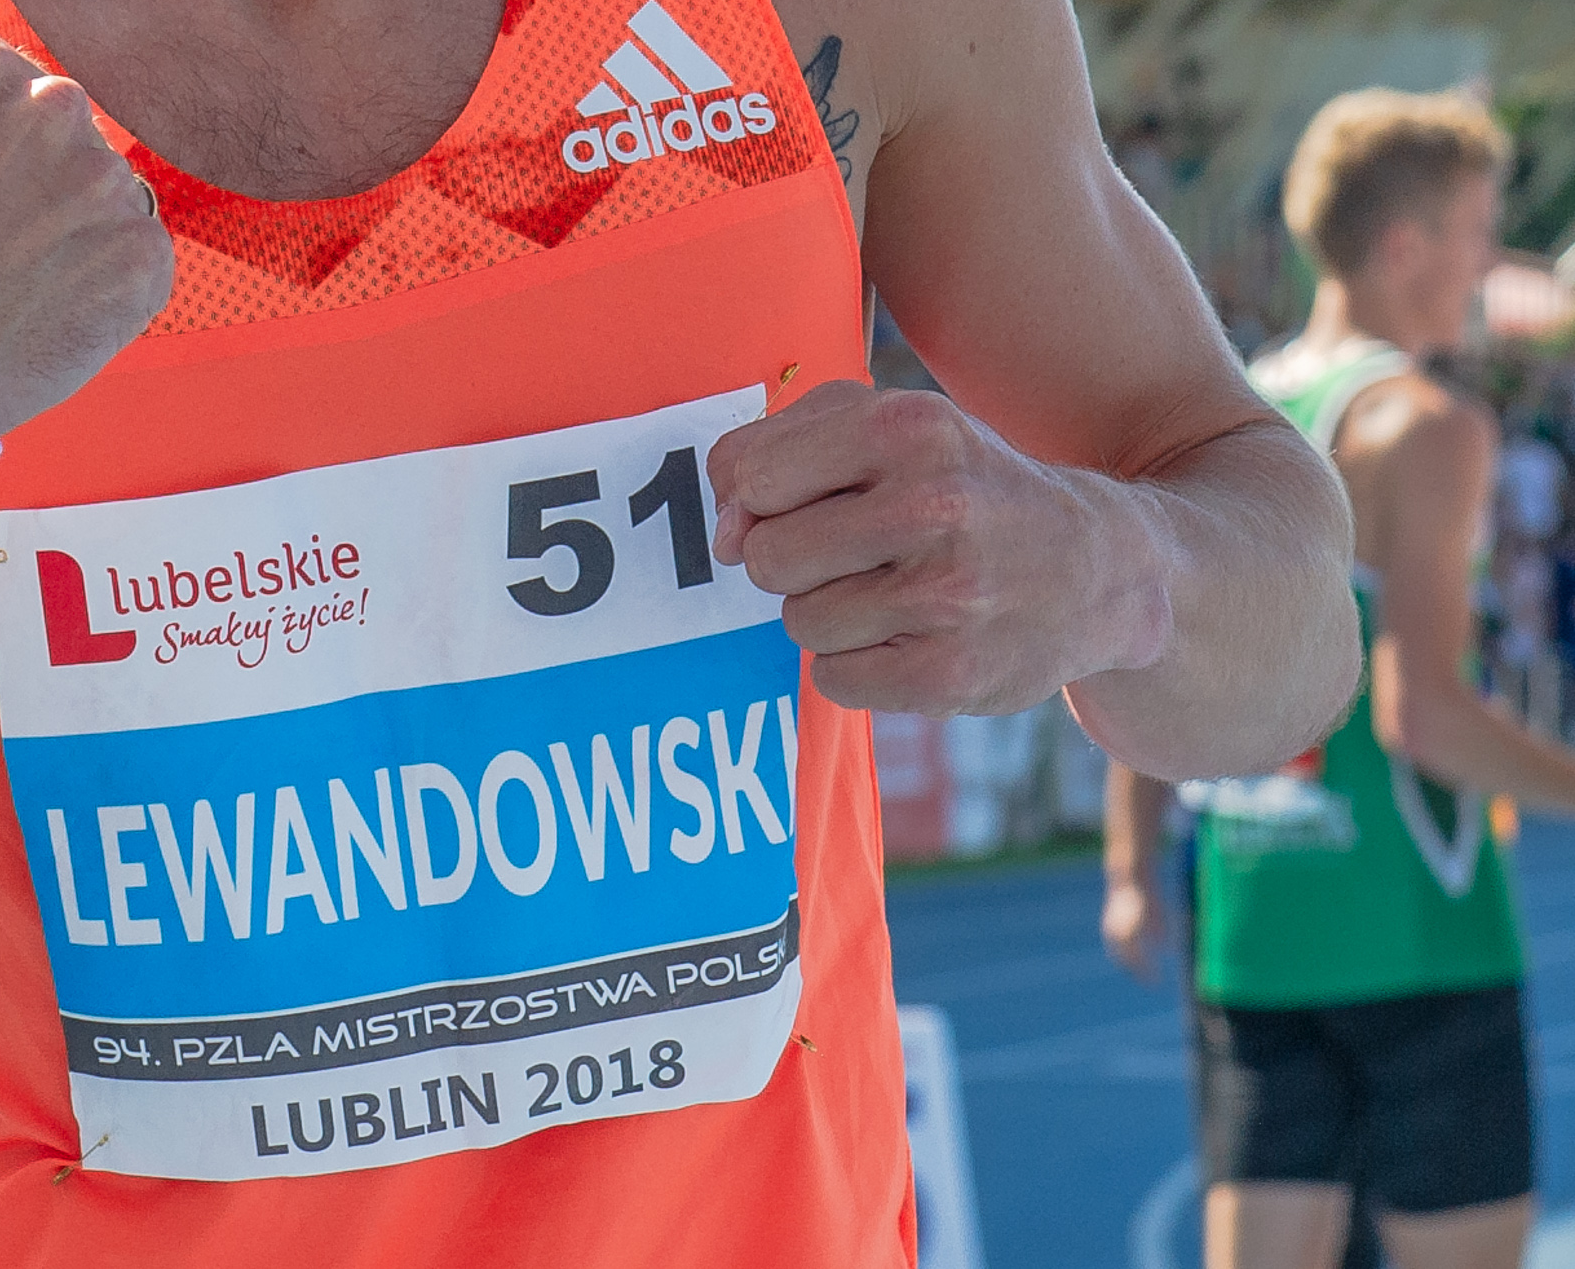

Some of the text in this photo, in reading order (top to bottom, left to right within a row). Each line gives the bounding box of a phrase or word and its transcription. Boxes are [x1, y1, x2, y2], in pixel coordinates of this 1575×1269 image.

[563, 92, 776, 173] adidas
[107, 534, 361, 615] lubelskie
[506, 446, 714, 616] 51
[154, 588, 370, 668] Smakuj życie!
[47, 695, 798, 946] LEWANDOWSKI
[93, 1036, 162, 1068] 94.
[173, 1031, 300, 1067] PZLA
[312, 971, 657, 1056] MISTRZOSTWA
[251, 1039, 687, 1157] LUBLIN 2018
